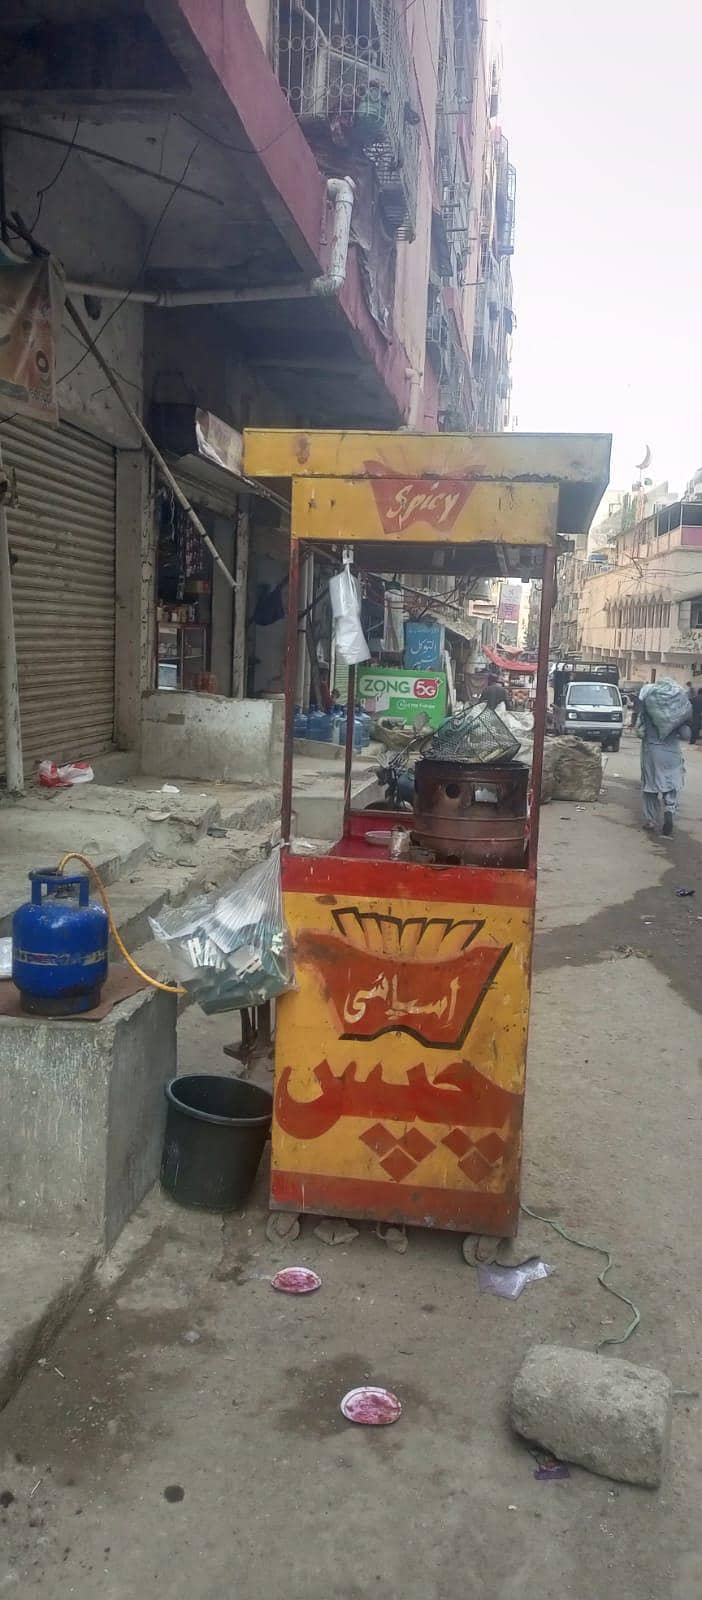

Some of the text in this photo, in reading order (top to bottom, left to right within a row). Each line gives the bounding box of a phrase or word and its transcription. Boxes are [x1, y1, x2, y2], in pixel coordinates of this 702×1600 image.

[386, 482, 461, 524] Spicy
[364, 679, 410, 693] ZONG
[274, 1059, 524, 1184] چپس
